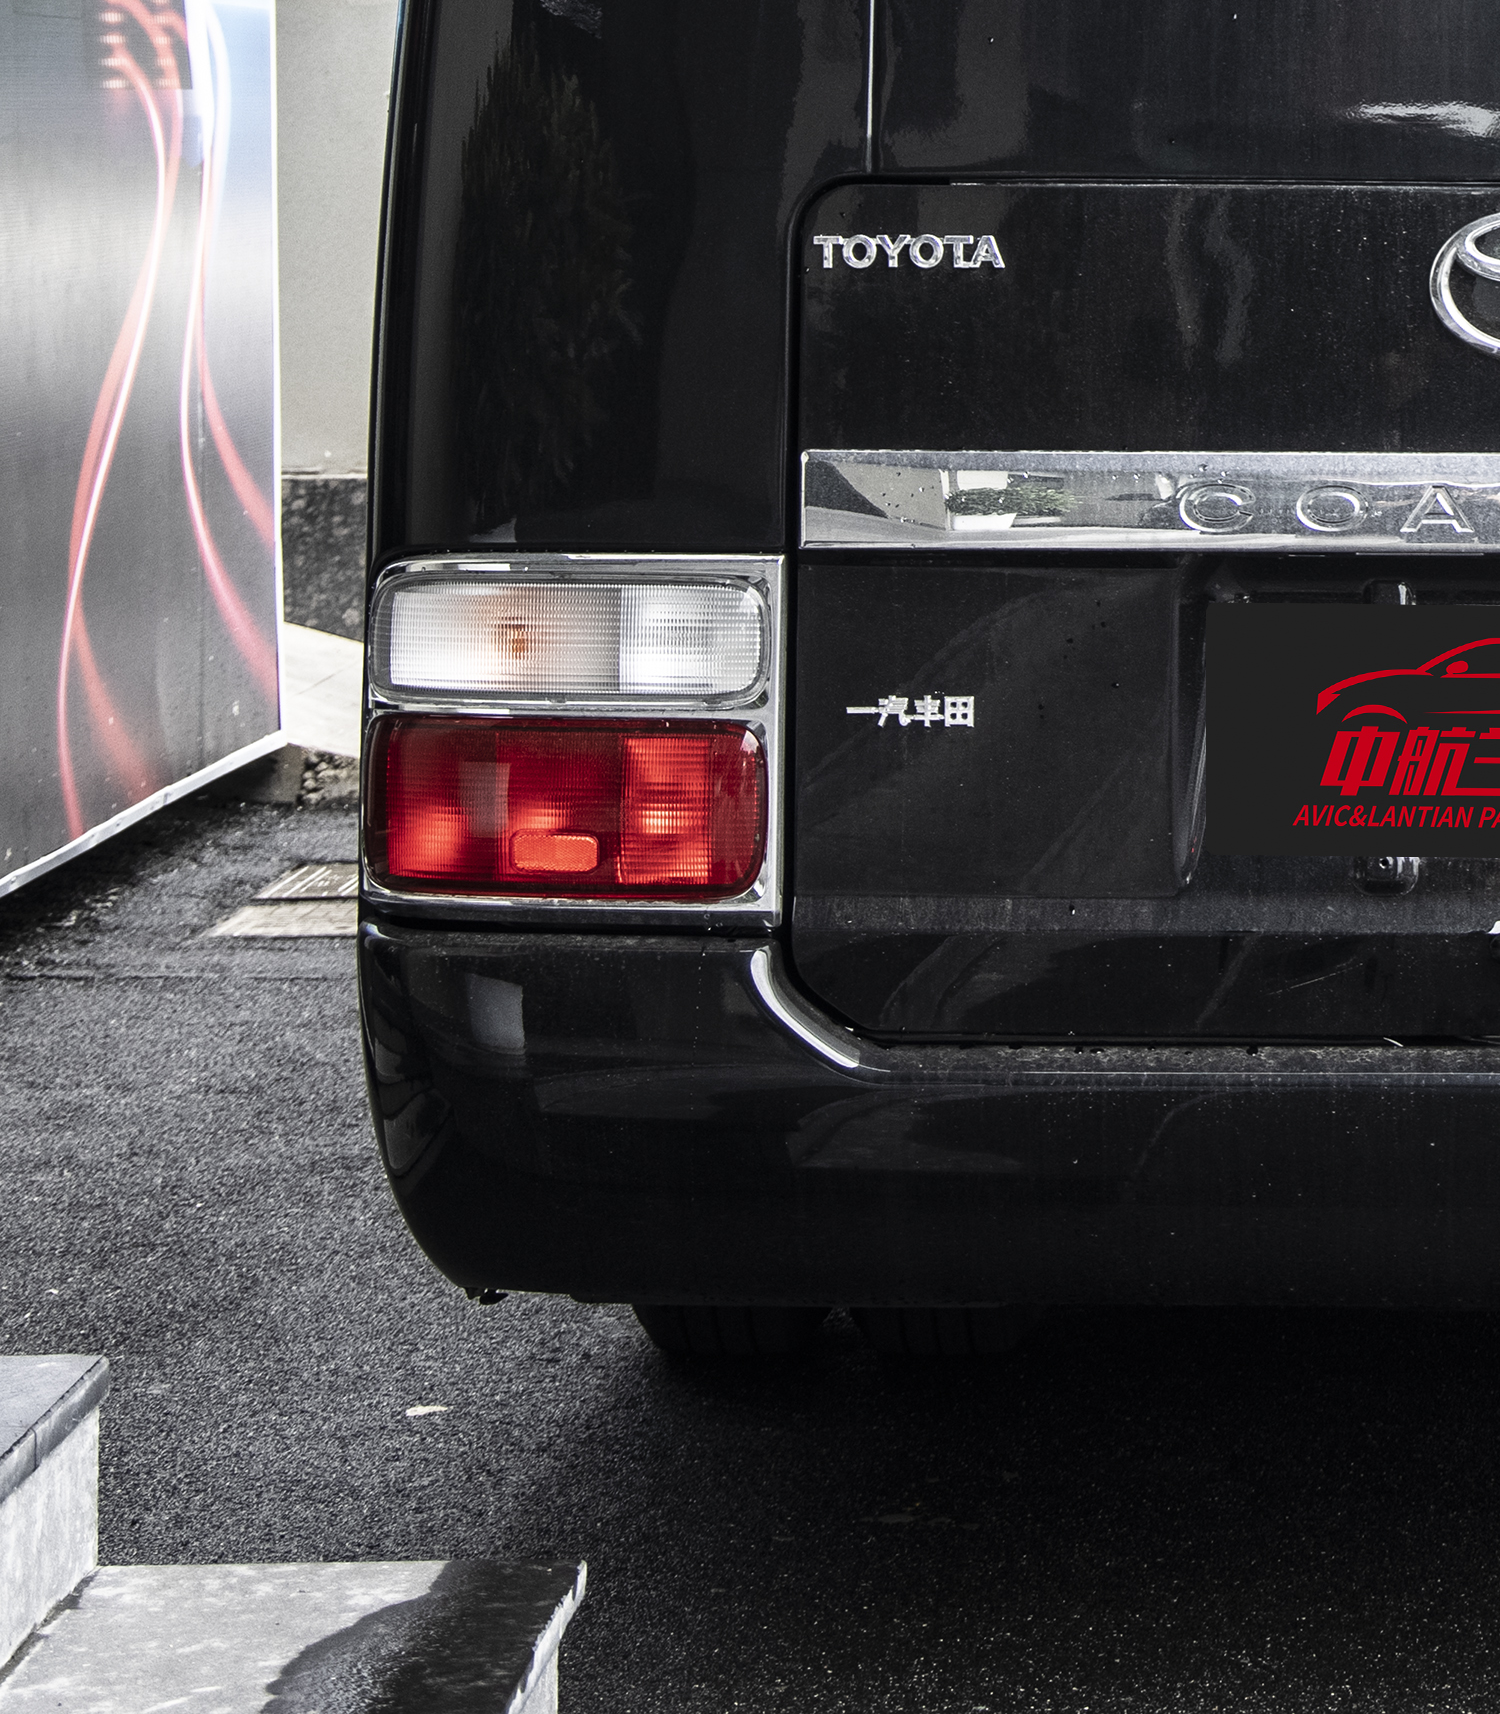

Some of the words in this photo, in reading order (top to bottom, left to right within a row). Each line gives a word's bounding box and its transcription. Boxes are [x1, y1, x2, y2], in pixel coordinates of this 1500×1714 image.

[813, 234, 1006, 269] TOYOTA
[845, 694, 975, 728] 一汽丰田
